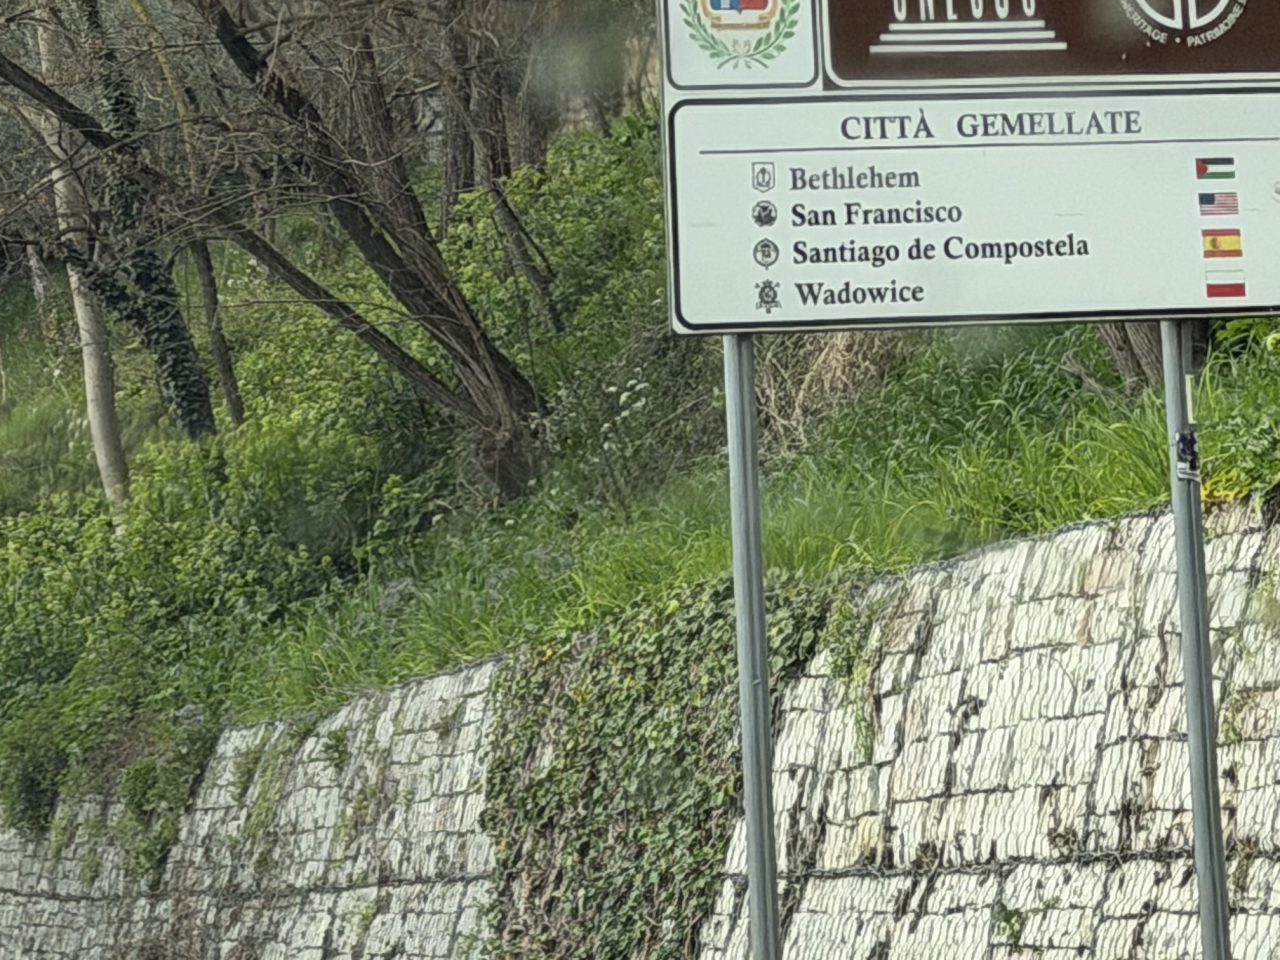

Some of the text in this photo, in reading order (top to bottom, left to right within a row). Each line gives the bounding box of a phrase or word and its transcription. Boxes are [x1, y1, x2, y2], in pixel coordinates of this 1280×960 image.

[840, 108, 1143, 141] CITTÀ GEMELLATE
[790, 166, 921, 192] Bethlehem
[791, 202, 963, 227] San Francisco
[792, 234, 1090, 267] Santiago de Compostela
[795, 280, 925, 307] Wadowice
